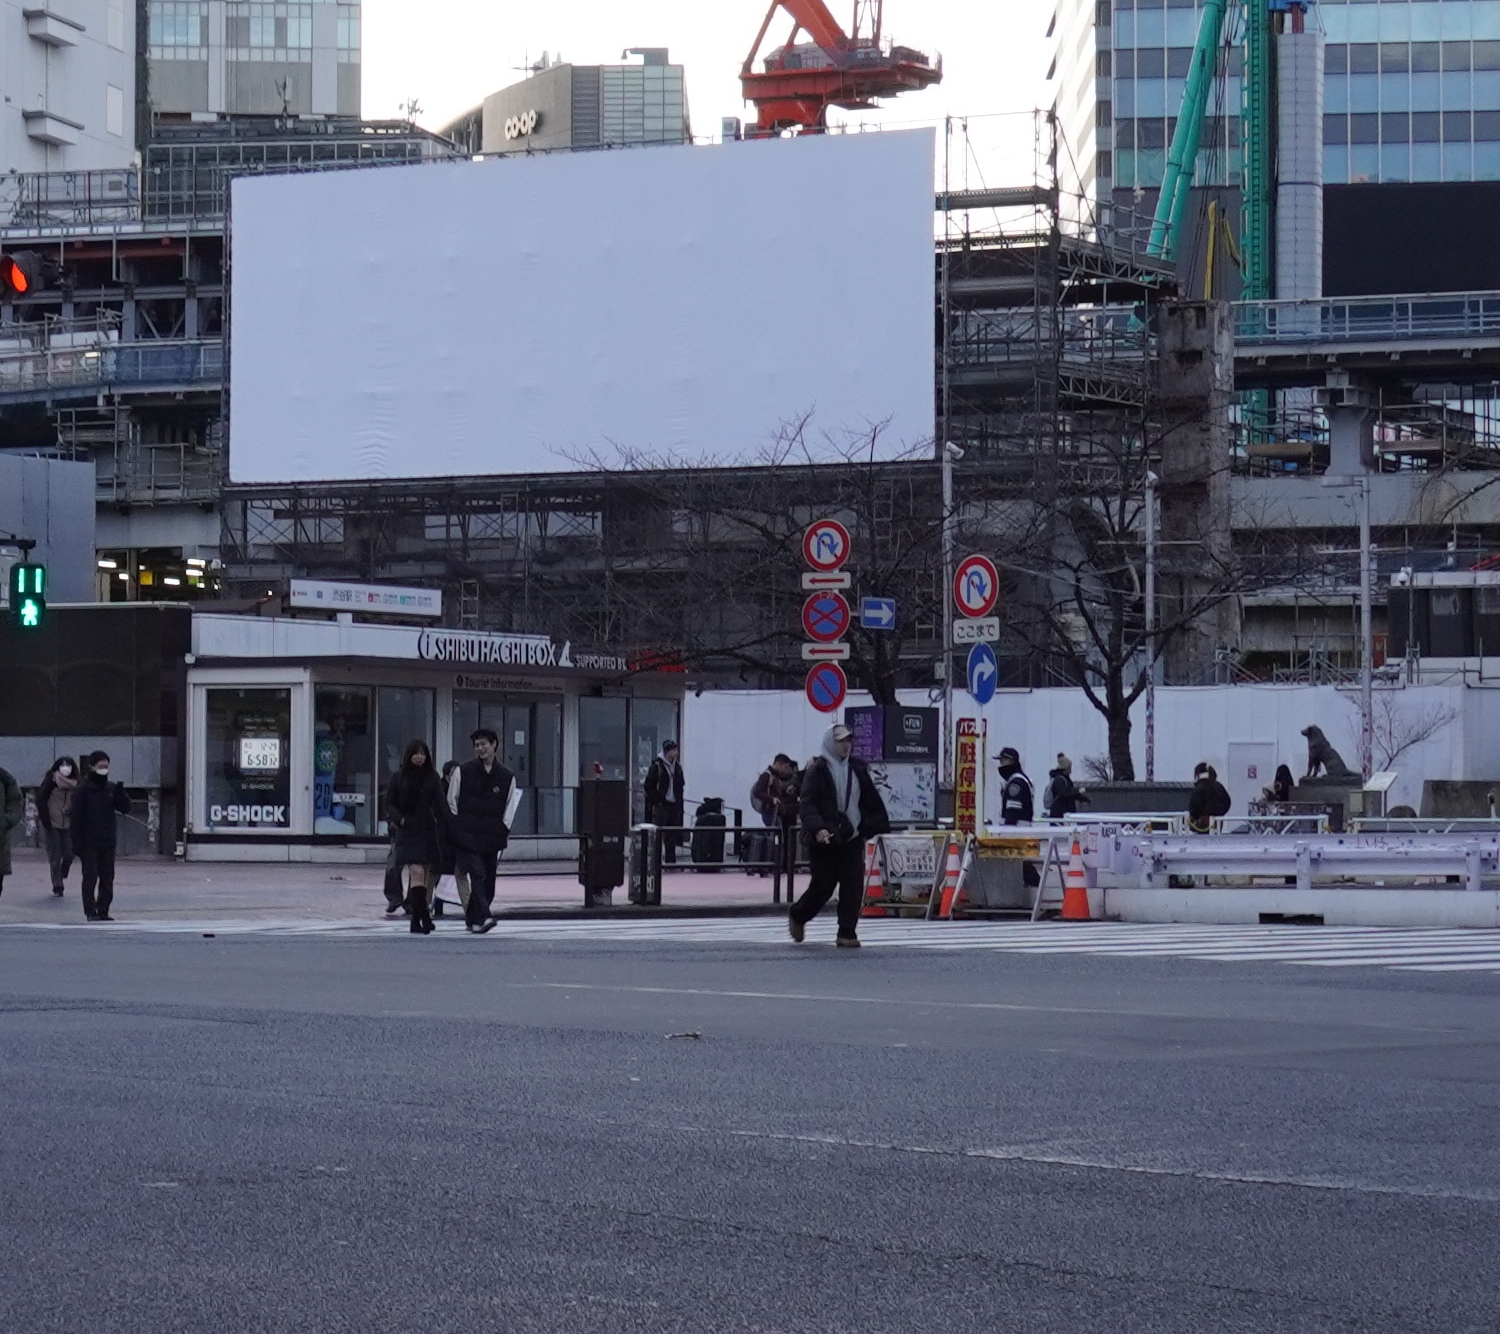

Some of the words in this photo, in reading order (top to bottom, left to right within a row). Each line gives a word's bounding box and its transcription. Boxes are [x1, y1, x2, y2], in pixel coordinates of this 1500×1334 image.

[957, 624, 996, 638] ここまで
[436, 637, 475, 661] SHIBU
[481, 640, 525, 665] HACHI
[528, 643, 557, 666] BOX
[576, 655, 616, 670] SUPPORTED
[211, 804, 285, 822] G-SHOCK
